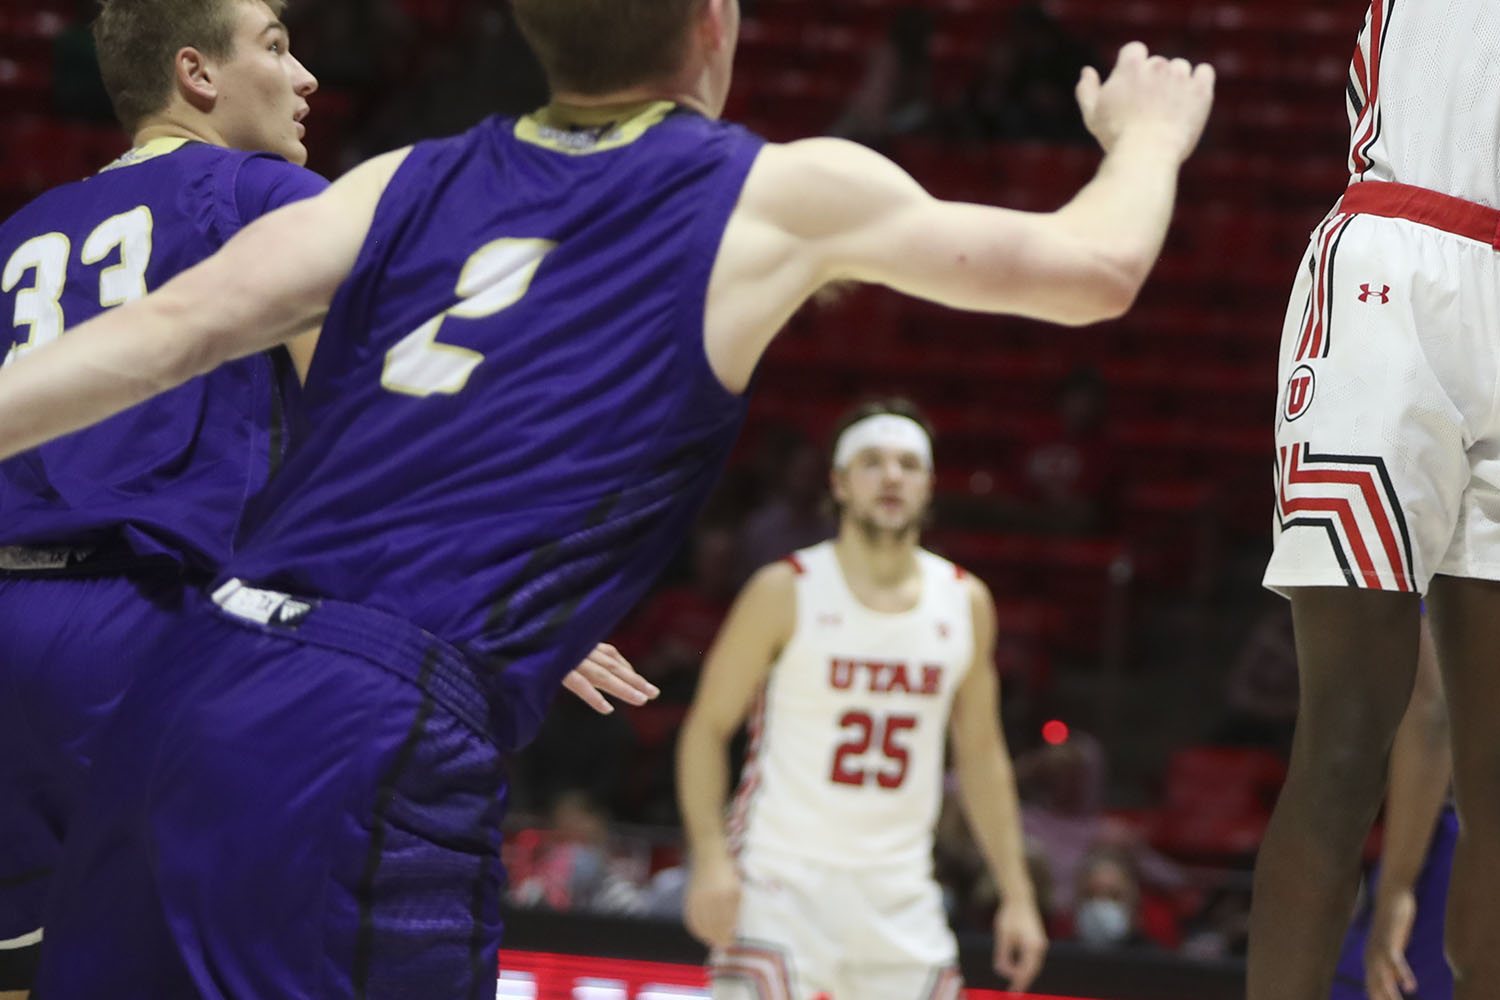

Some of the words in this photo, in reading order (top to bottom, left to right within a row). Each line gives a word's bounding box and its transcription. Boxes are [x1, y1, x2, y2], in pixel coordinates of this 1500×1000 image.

[380, 237, 560, 397] 2
[1289, 376, 1311, 415] U
[828, 656, 944, 697] UTAH
[829, 711, 919, 791] 25
